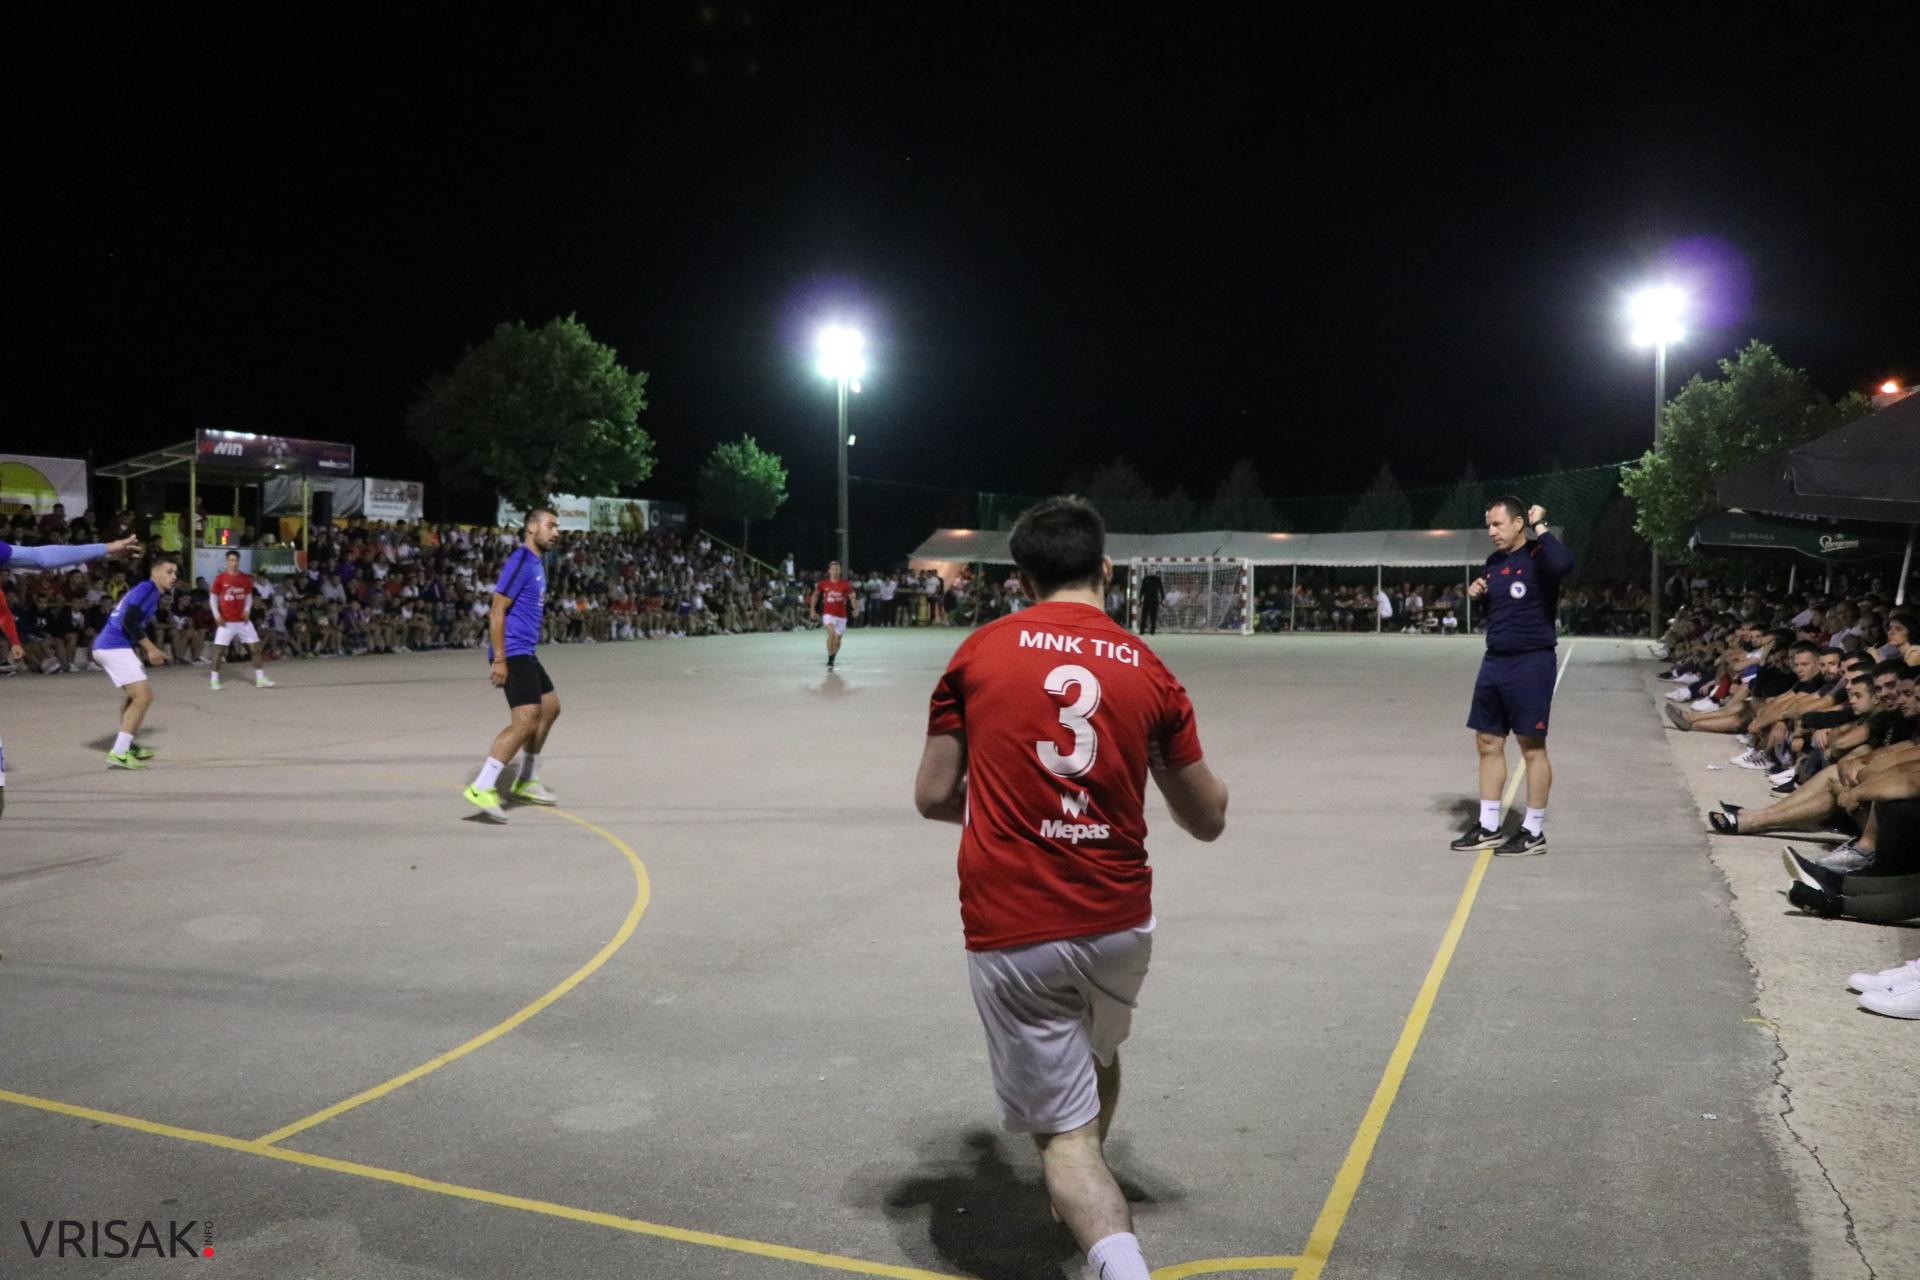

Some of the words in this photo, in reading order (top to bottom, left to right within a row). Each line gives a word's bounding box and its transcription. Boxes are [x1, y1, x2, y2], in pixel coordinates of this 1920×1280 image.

[1019, 630, 1084, 654] MNK
[1036, 664, 1102, 778] 3
[1040, 819, 1111, 845] Mepas
